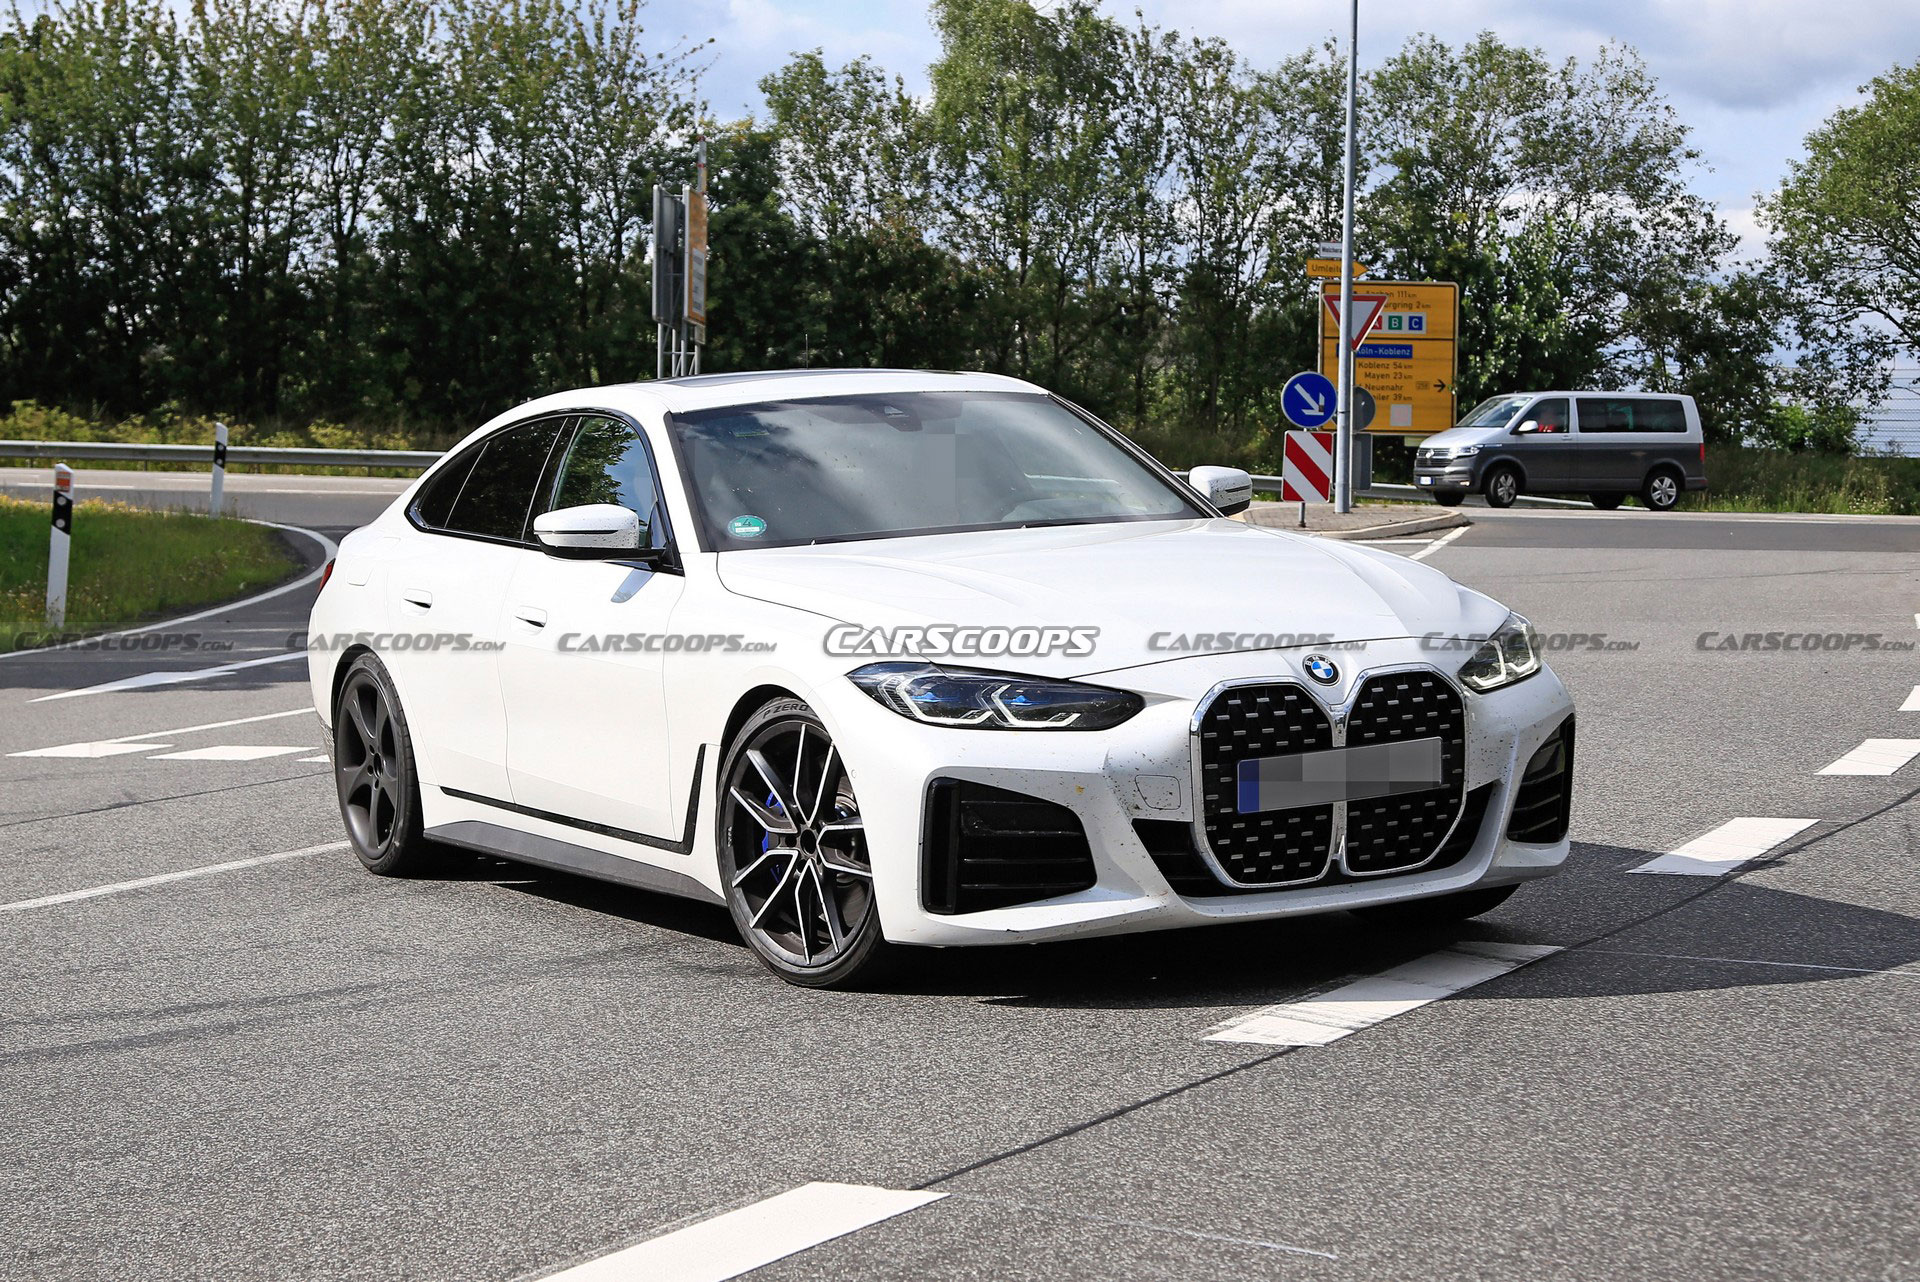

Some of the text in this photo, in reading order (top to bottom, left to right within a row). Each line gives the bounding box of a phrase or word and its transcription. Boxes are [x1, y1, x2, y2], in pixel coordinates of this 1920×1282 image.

[1312, 264, 1342, 273] Umleit
[1384, 302, 1413, 310] urgring
[1392, 318, 1399, 328] B
[1412, 318, 1420, 328] C
[1378, 346, 1410, 356] Koblenz
[1364, 372, 1390, 380] Mayen
[742, 518, 752, 526] 4
[762, 703, 810, 719] P ZERO
